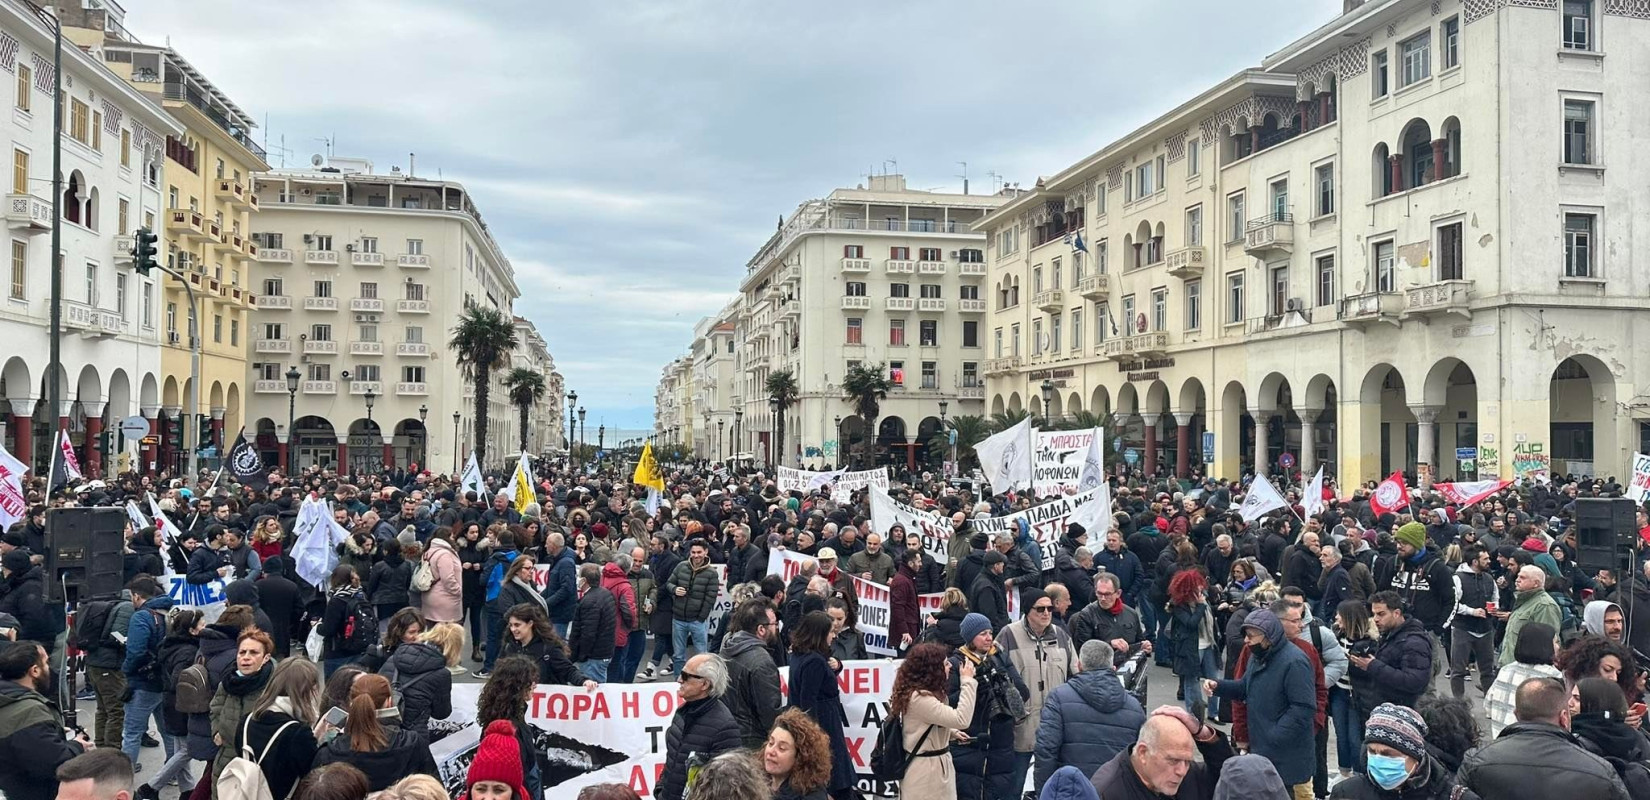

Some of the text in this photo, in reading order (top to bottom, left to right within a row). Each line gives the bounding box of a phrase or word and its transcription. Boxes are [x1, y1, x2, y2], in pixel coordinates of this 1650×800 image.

[840, 471, 885, 481] ΓΚΛΗΜΑΤΟΣ
[1034, 466, 1080, 481] ΛΟΦΟΝΩΝ
[857, 604, 889, 629] ΡΟΝΕΣ,
[531, 691, 611, 721] ΤΩΡΑ
[622, 692, 640, 718] Η
[837, 667, 880, 694] ΝΕΙ
